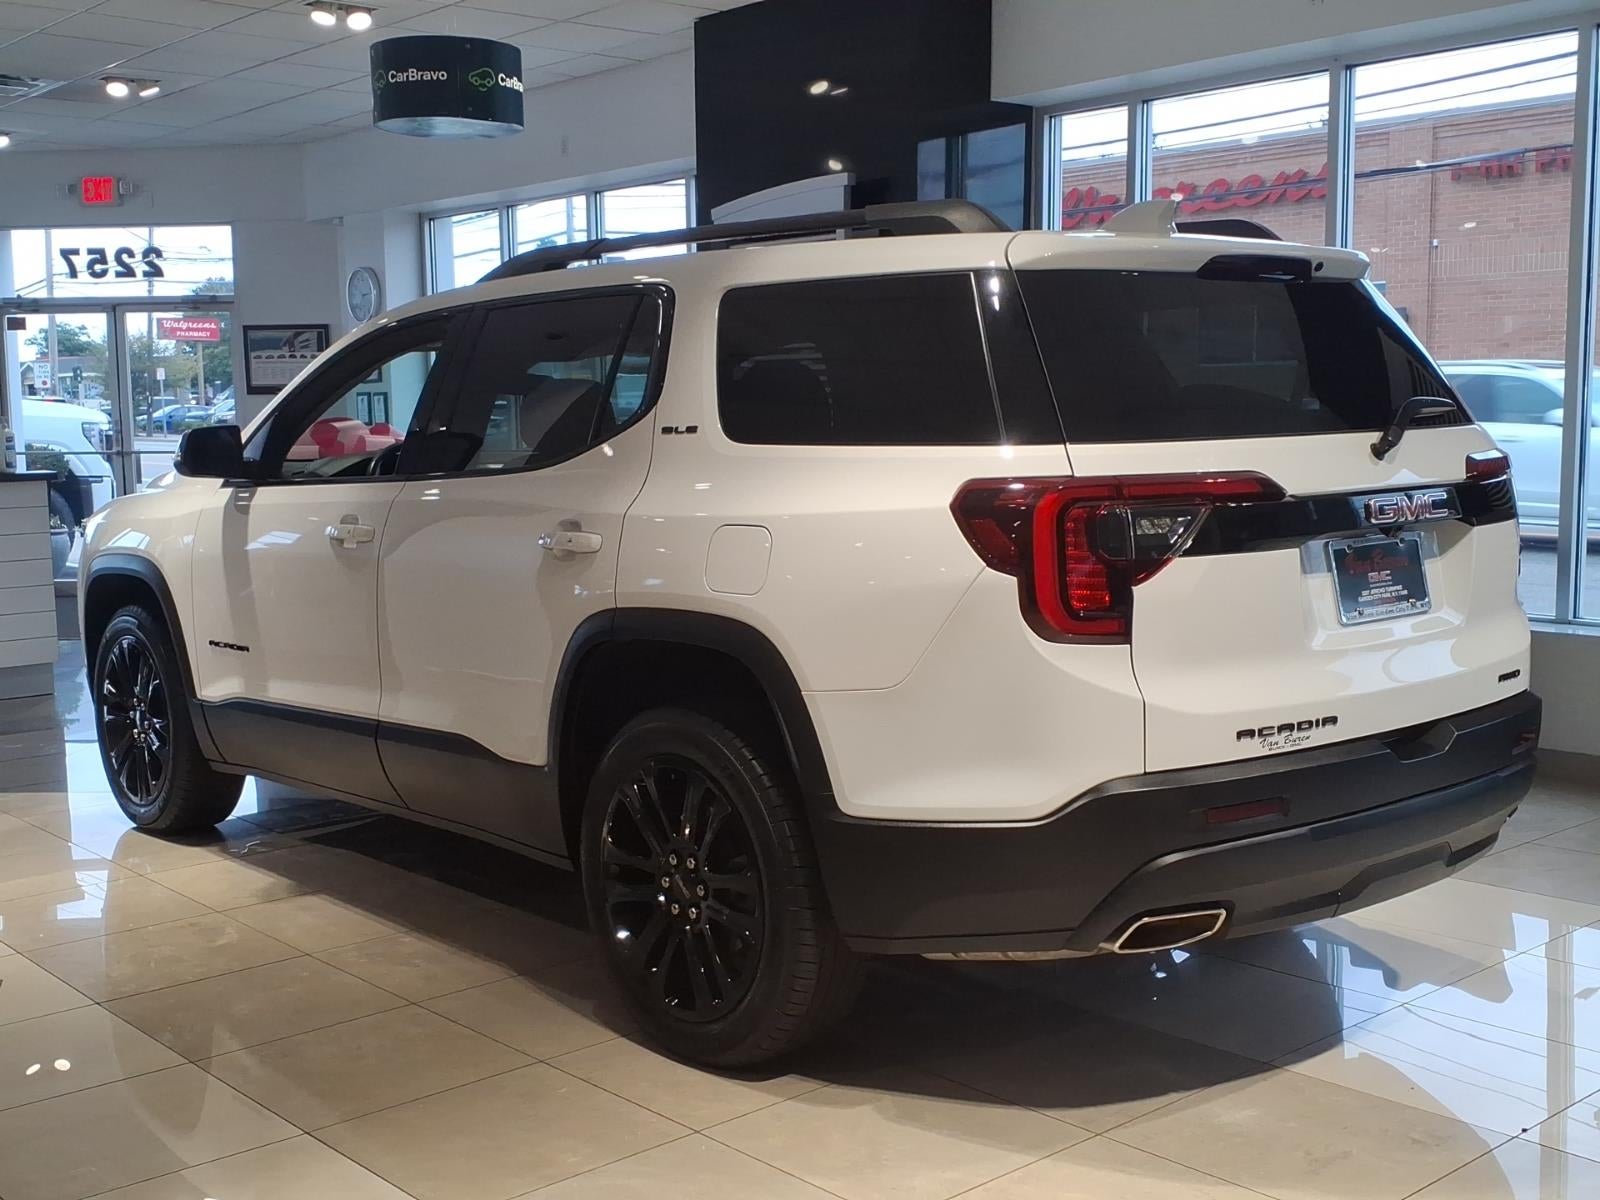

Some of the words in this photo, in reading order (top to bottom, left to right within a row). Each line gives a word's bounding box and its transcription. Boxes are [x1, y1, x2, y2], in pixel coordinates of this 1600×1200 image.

[388, 68, 448, 83] CarBravo
[498, 73, 524, 93] CarBra
[161, 320, 217, 330] Walgreens
[1367, 492, 1449, 524] GMC
[208, 640, 250, 653] ACADIA
[1236, 715, 1339, 742] ACADIA
[1259, 738, 1279, 749] Van
[1283, 733, 1312, 745] Buren
